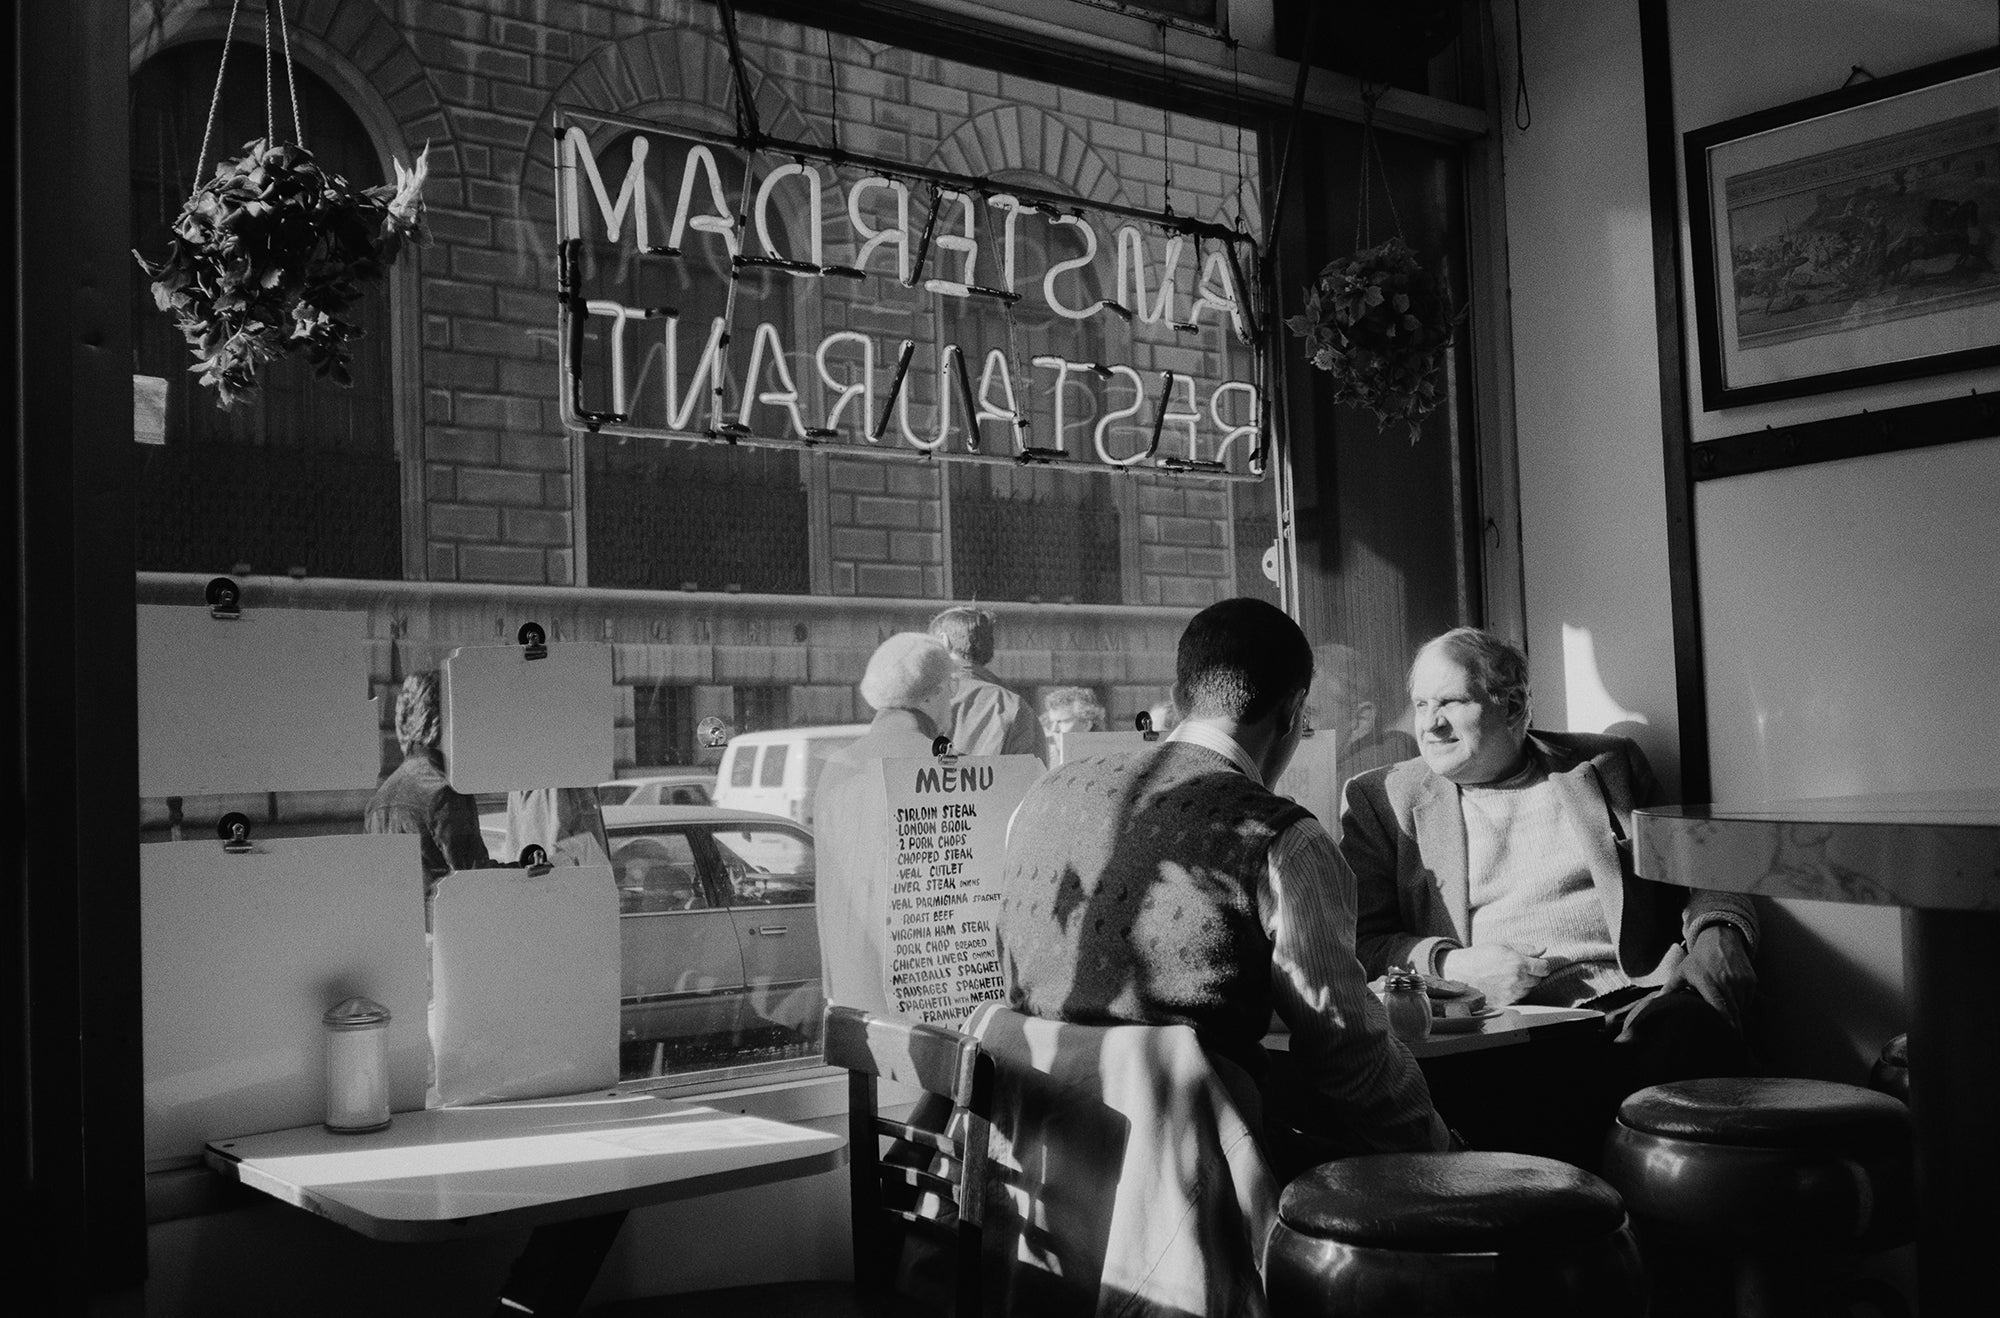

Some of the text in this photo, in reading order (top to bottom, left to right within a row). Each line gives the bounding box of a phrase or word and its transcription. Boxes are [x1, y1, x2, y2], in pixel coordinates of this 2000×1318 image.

[915, 765, 994, 794] MENU
[896, 803, 977, 822] SIRLOIN STEAK
[898, 820, 972, 836] LONDON BROIL
[900, 834, 967, 850] 2 PORK CHOPS
[897, 848, 973, 865] CHOPPED STEAK
[900, 863, 964, 880] VEAL CUTLET
[893, 880, 921, 894] LIVER
[926, 878, 956, 892] STEAK
[891, 898, 913, 911] VEAL
[903, 909, 955, 925] ROAST BEEF
[891, 920, 991, 942] VIRGINIA HAM STEAK
[896, 938, 988, 956] PORK CHOP BREADED
[892, 956, 934, 972] CHICKEN
[937, 951, 968, 966] LIVERS
[892, 967, 952, 986] MEATBALLS
[895, 975, 1004, 999] SAUSAGES SPAGHETTI
[898, 996, 952, 1013] SPAGHETTI
[922, 1004, 978, 1023] FRANKFUR
